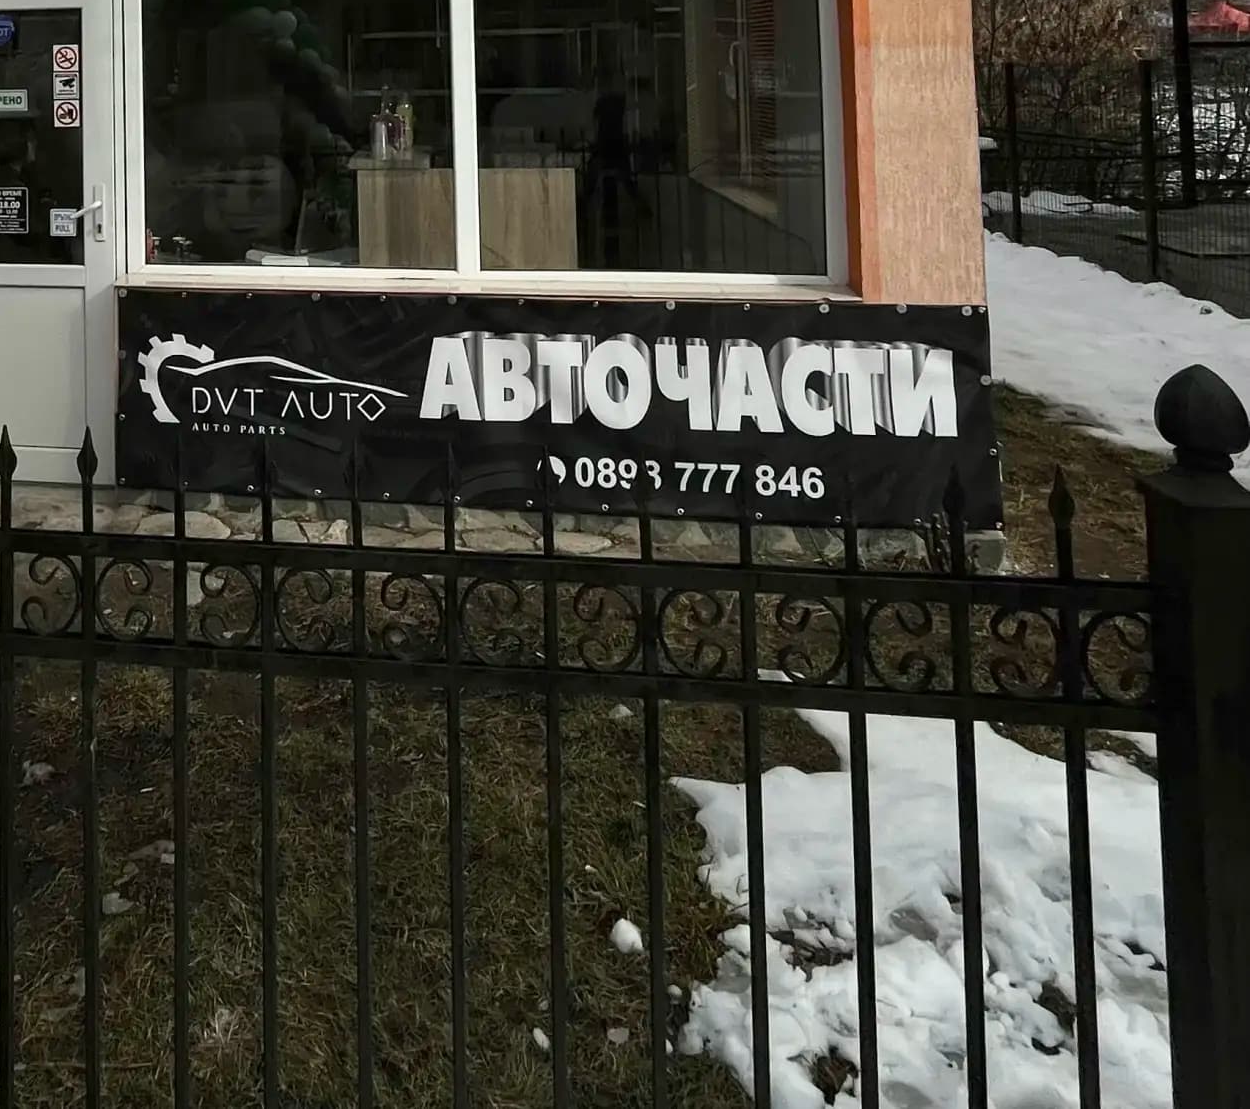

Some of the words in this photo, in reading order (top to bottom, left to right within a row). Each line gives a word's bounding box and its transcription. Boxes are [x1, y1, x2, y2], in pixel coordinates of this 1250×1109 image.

[419, 331, 958, 438] АВТОЧАСТИ
[191, 387, 264, 417] DVT
[281, 389, 386, 422] AUTO
[191, 422, 231, 433] AUTO
[239, 425, 286, 436] PARTS
[674, 461, 741, 494] 777
[754, 464, 826, 499] 846
